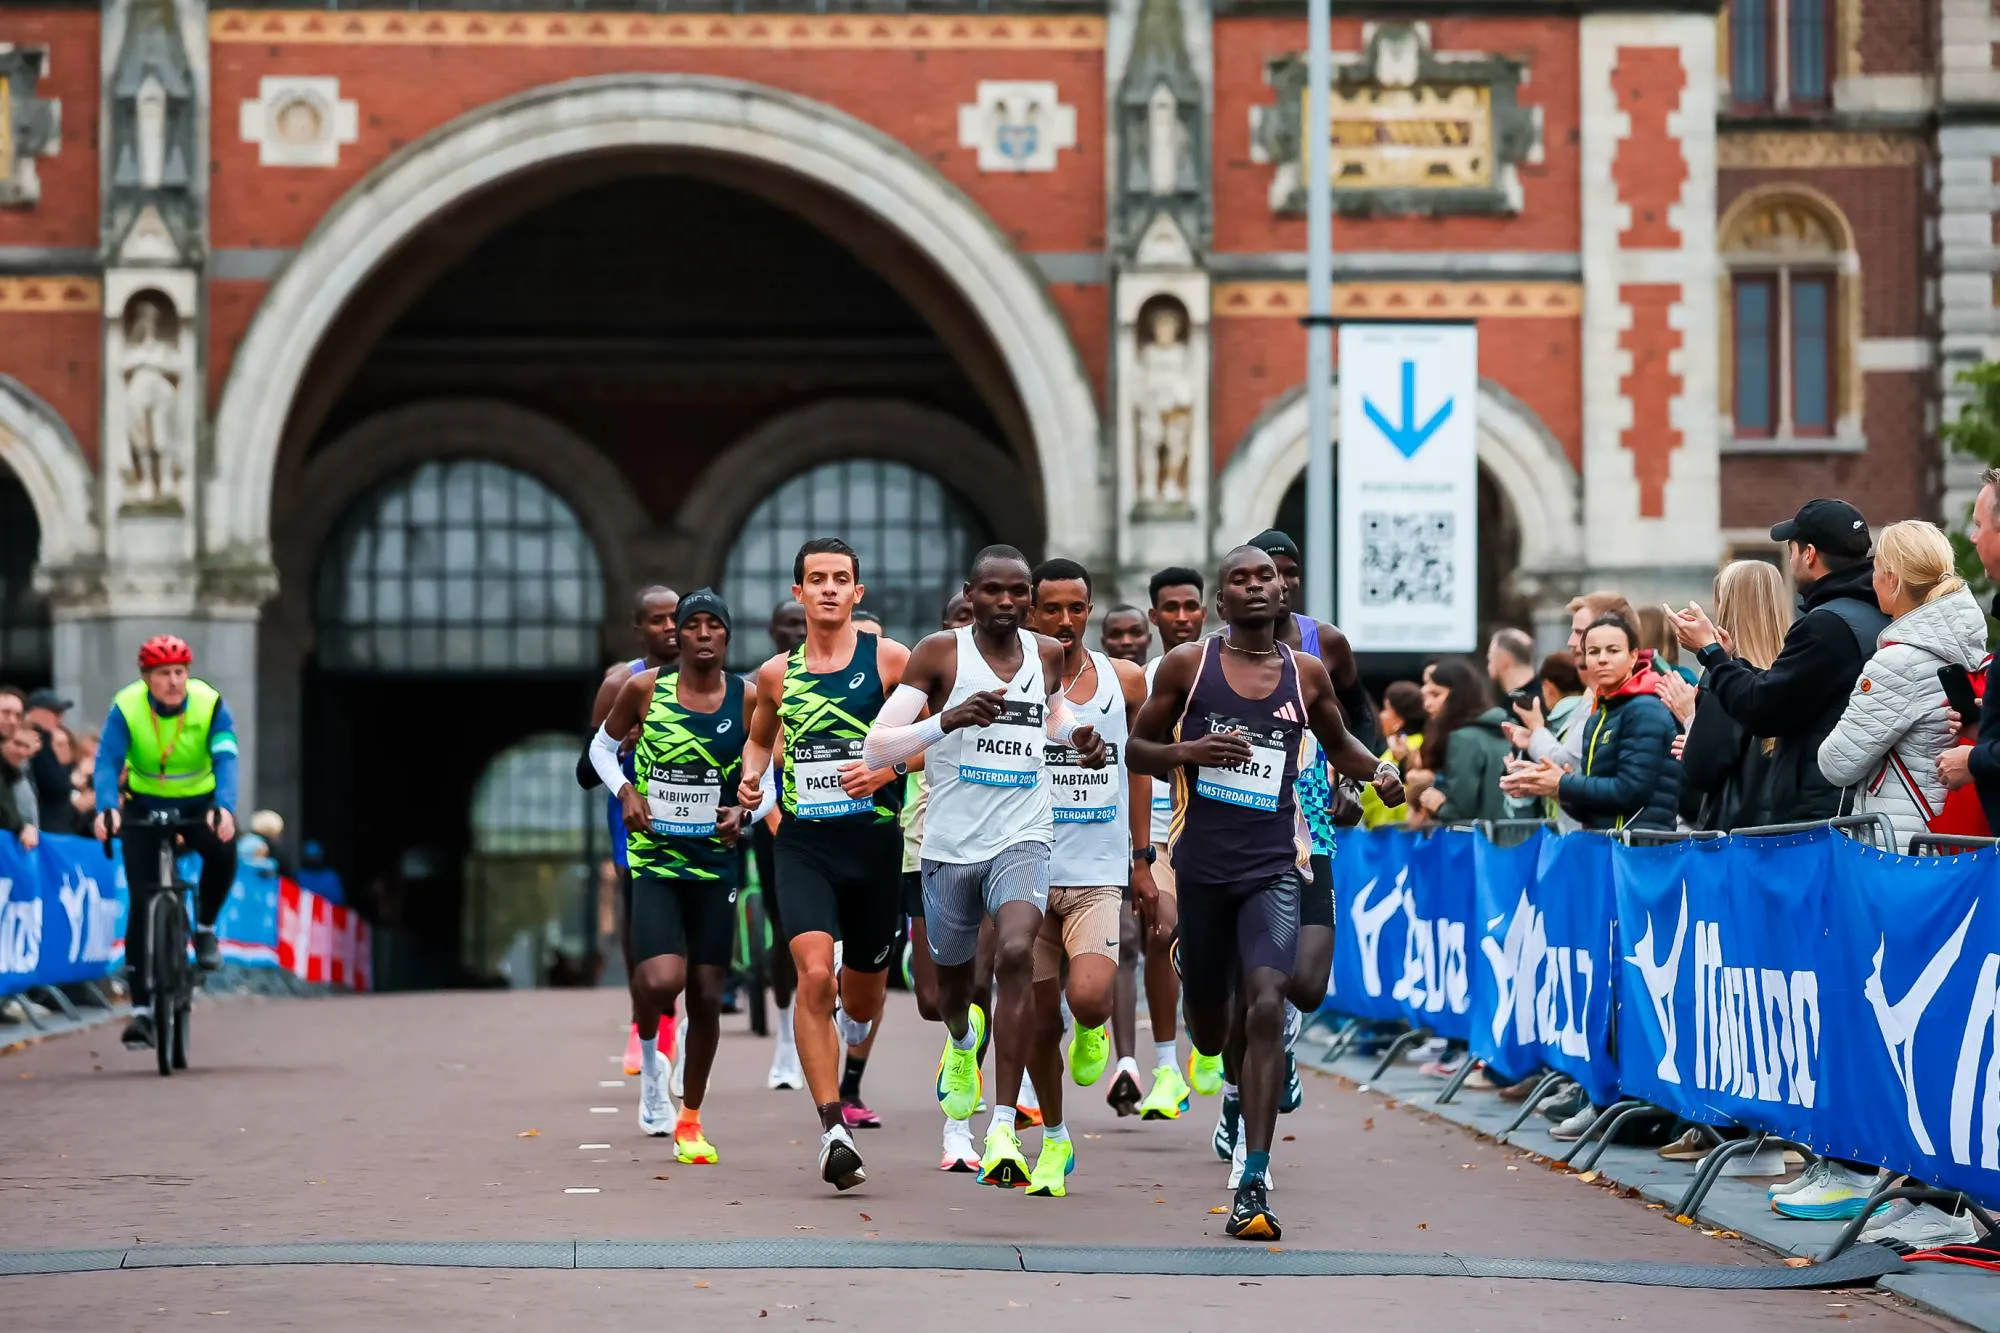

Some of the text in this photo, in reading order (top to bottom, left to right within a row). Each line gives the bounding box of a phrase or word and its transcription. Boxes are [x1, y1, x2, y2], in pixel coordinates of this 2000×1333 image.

[976, 738, 1032, 757] PACER 6
[1268, 739, 1284, 748] TATA
[795, 747, 812, 760] tcs
[1043, 750, 1064, 763] tcs
[653, 765, 670, 781] tcs
[961, 768, 1036, 784] AMSTERDAM 2024
[1262, 764, 1272, 779] 2
[1052, 773, 1109, 786] HABTAMU
[658, 789, 710, 803] KIBIWOTT
[1073, 790, 1087, 802] 31
[1197, 783, 1276, 808] AMSTERDAM 2024
[675, 806, 689, 817] 25
[798, 799, 872, 816] AMSTERDAM 2024
[1054, 809, 1116, 820] STERDAM 2024
[655, 823, 694, 833] STERDAM
